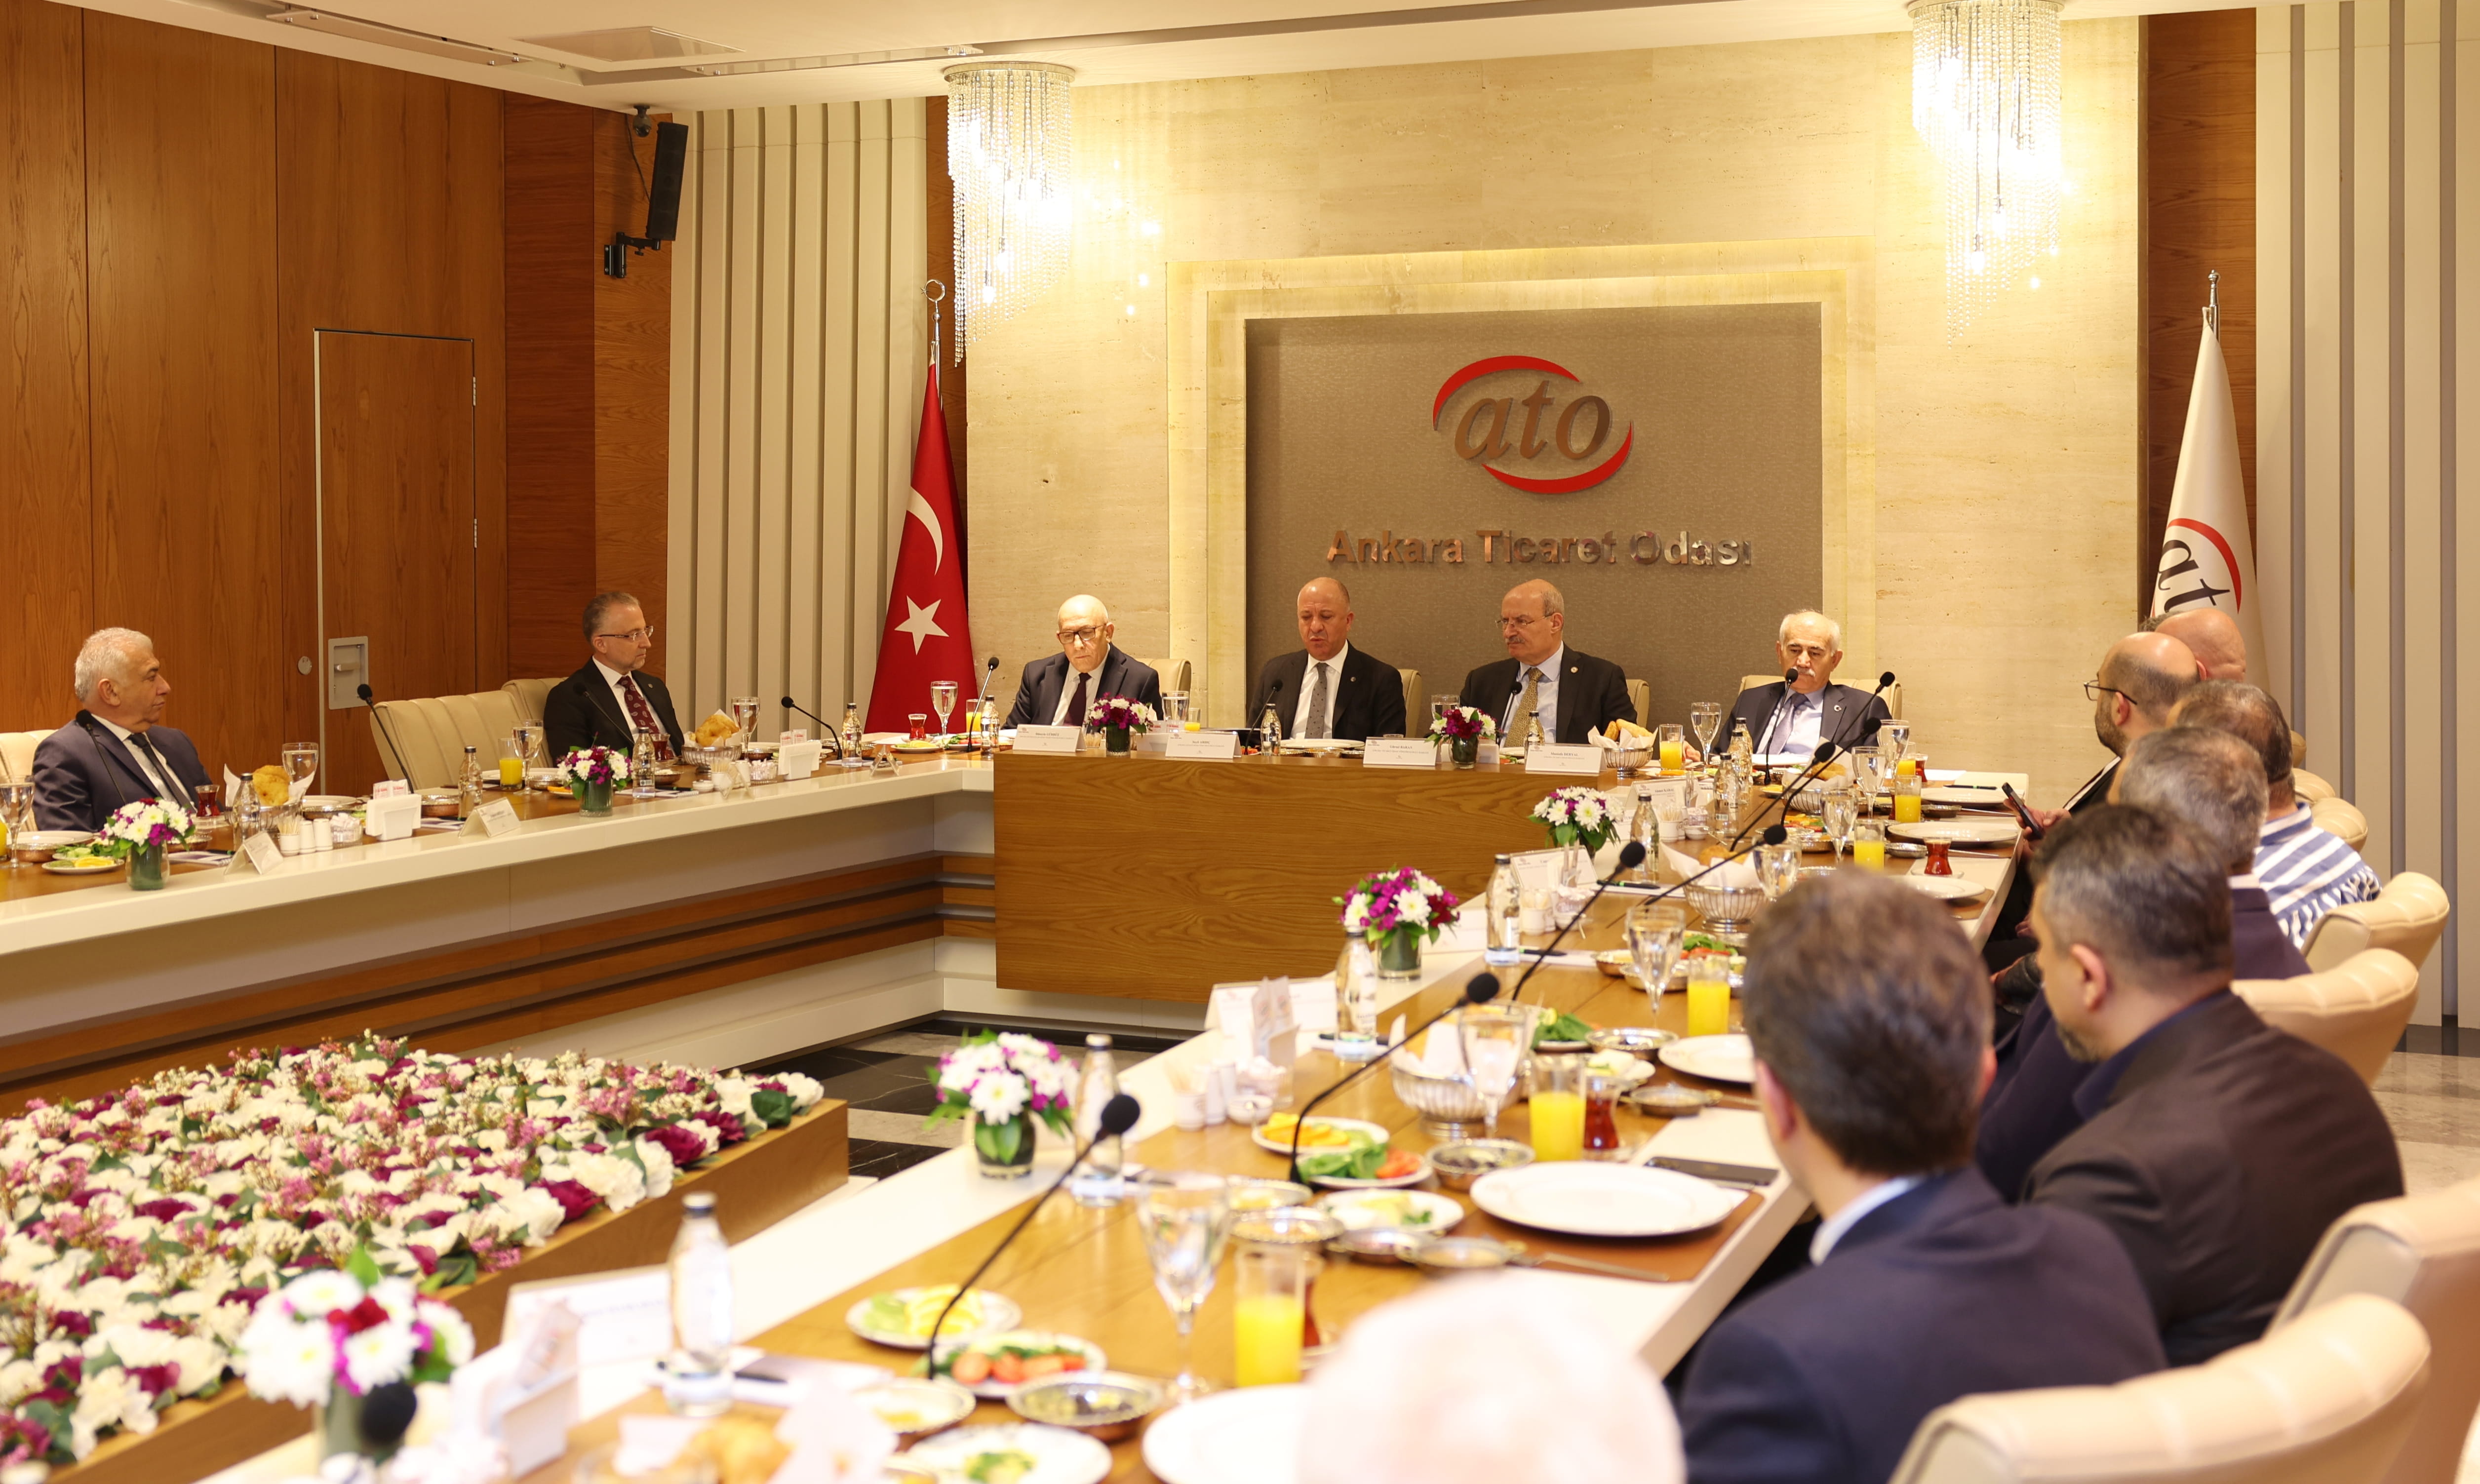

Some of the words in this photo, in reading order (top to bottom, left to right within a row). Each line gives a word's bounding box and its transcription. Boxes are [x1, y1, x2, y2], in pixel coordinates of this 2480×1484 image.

[1455, 380, 1611, 460] ato
[1327, 530, 1463, 563] Ankara
[1476, 530, 1616, 563] Ticaret
[1629, 530, 1751, 565] Odası
[2158, 540, 2230, 613] at
